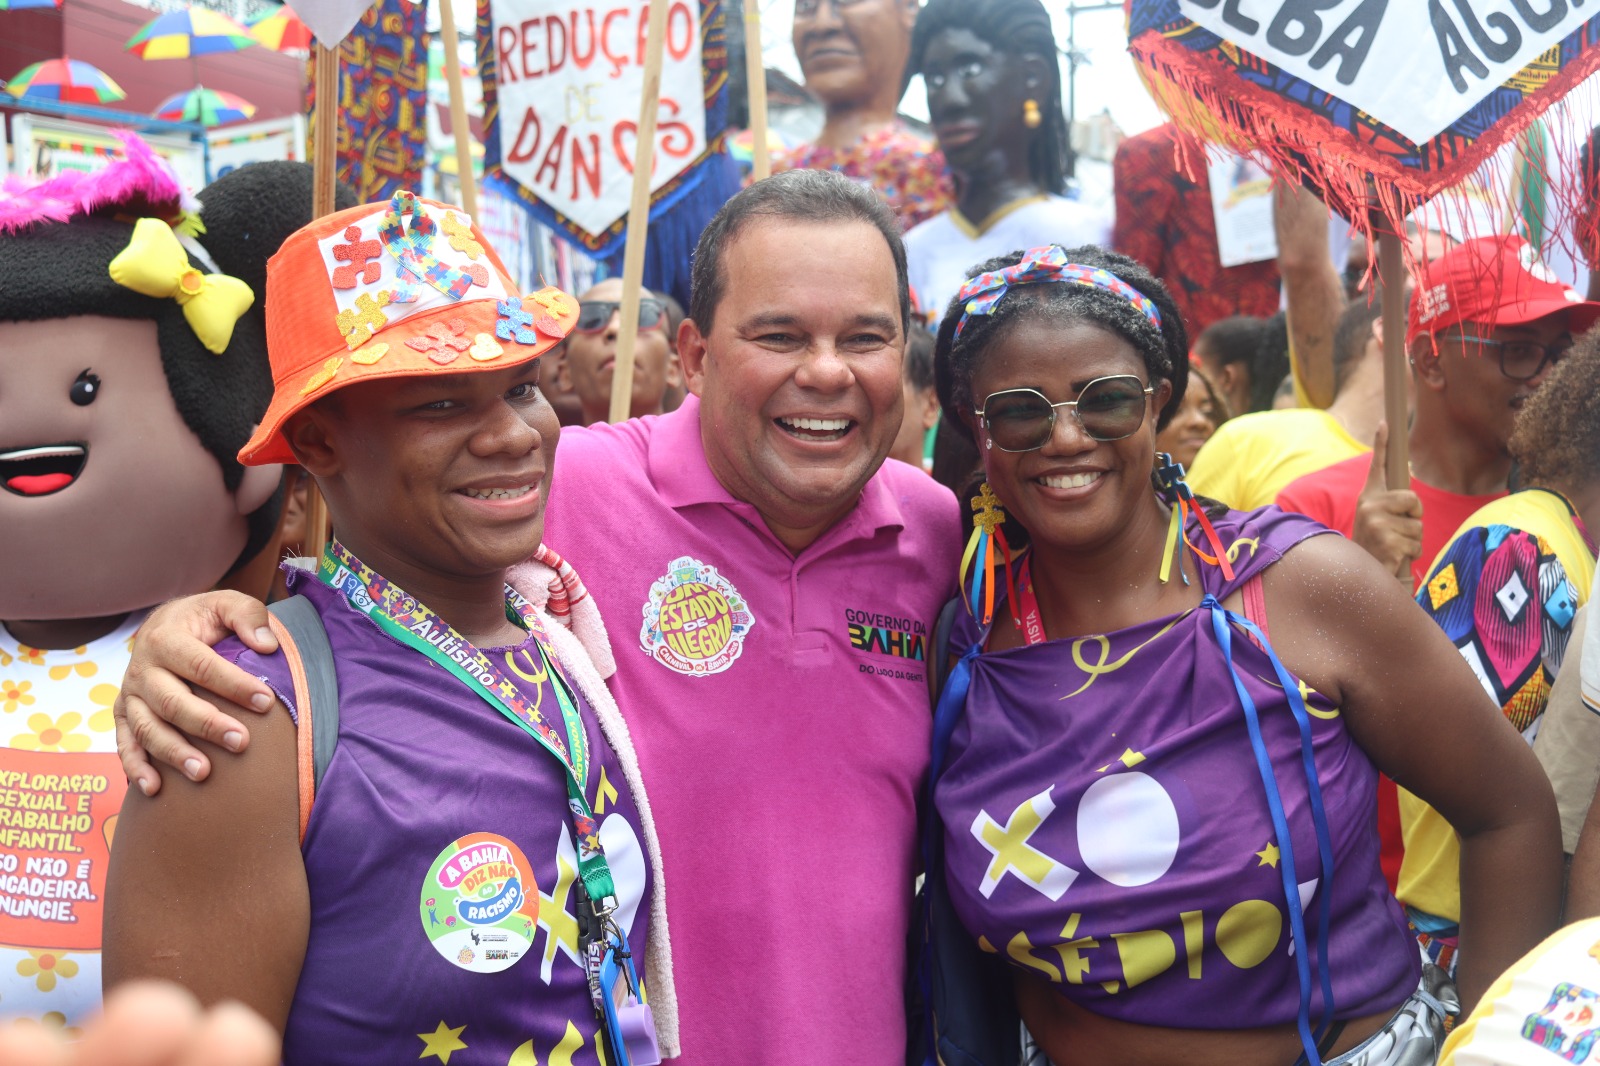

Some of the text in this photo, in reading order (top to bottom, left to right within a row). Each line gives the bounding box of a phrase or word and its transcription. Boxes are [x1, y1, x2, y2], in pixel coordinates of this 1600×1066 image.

[1428, 0, 1584, 94] AGU
[563, 83, 604, 124] DE
[507, 97, 695, 200] DANOS
[666, 582, 709, 604] UM
[660, 590, 729, 632] ESTADO
[682, 617, 708, 632] DE
[845, 608, 927, 637] GOVERNO DA
[410, 620, 495, 686] Autismo
[666, 614, 732, 659] ALEGRIA
[848, 622, 926, 661] BAHIA
[659, 647, 692, 671] CARNAVAL
[707, 654, 729, 671] BAHIA
[860, 664, 875, 675] DO
[876, 667, 894, 678] LADO
[895, 670, 905, 679] DA
[77, 794, 91, 813] E
[26, 857, 68, 878] NÃO
[76, 859, 91, 879] É
[445, 846, 509, 883] A BAHIA
[464, 860, 516, 892] DIZ NÃO
[468, 886, 518, 920] RACISMO
